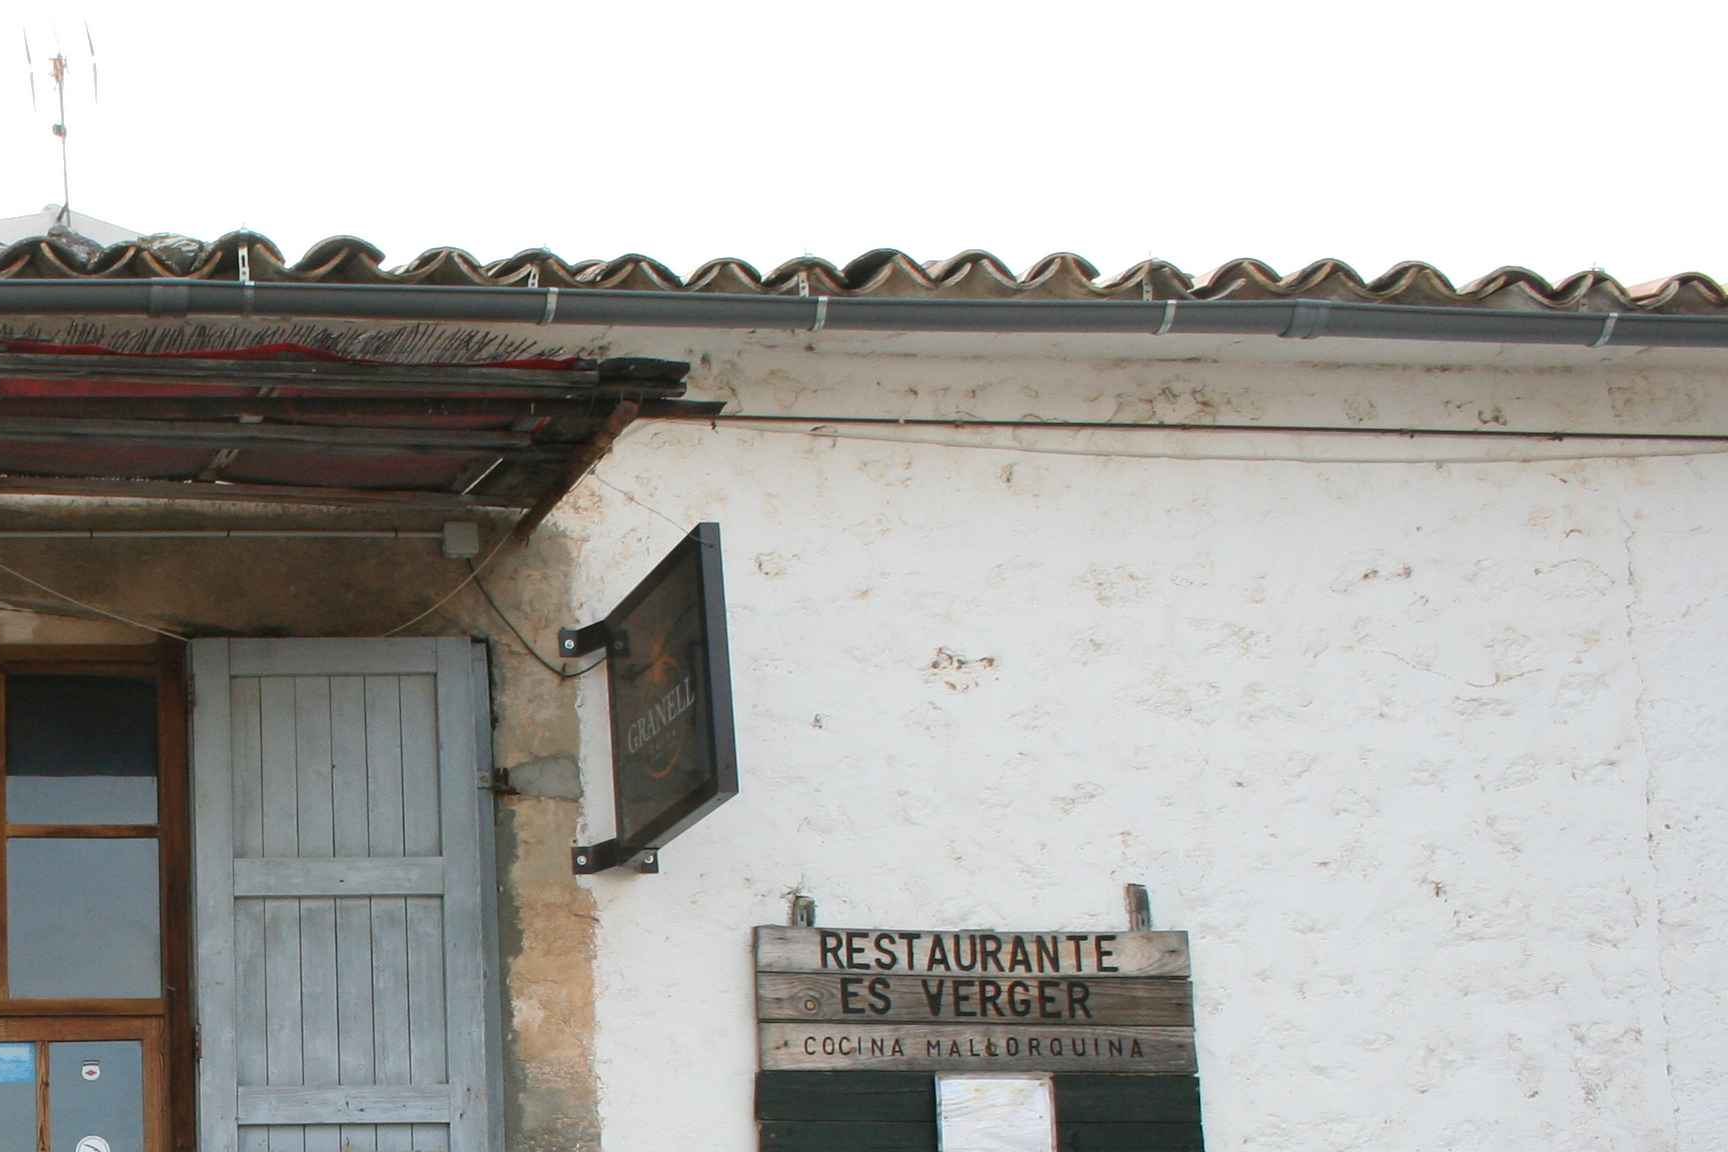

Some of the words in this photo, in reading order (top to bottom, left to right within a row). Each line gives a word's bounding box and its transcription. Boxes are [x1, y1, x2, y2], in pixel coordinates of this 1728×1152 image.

[627, 677, 696, 753] GRANELL
[819, 930, 1121, 974] RESTAURANTE
[839, 976, 893, 1016] ES
[921, 979, 1093, 1020] VERGER
[803, 1035, 905, 1057] COCINA
[925, 1036, 1145, 1059] MALLORQUINA
